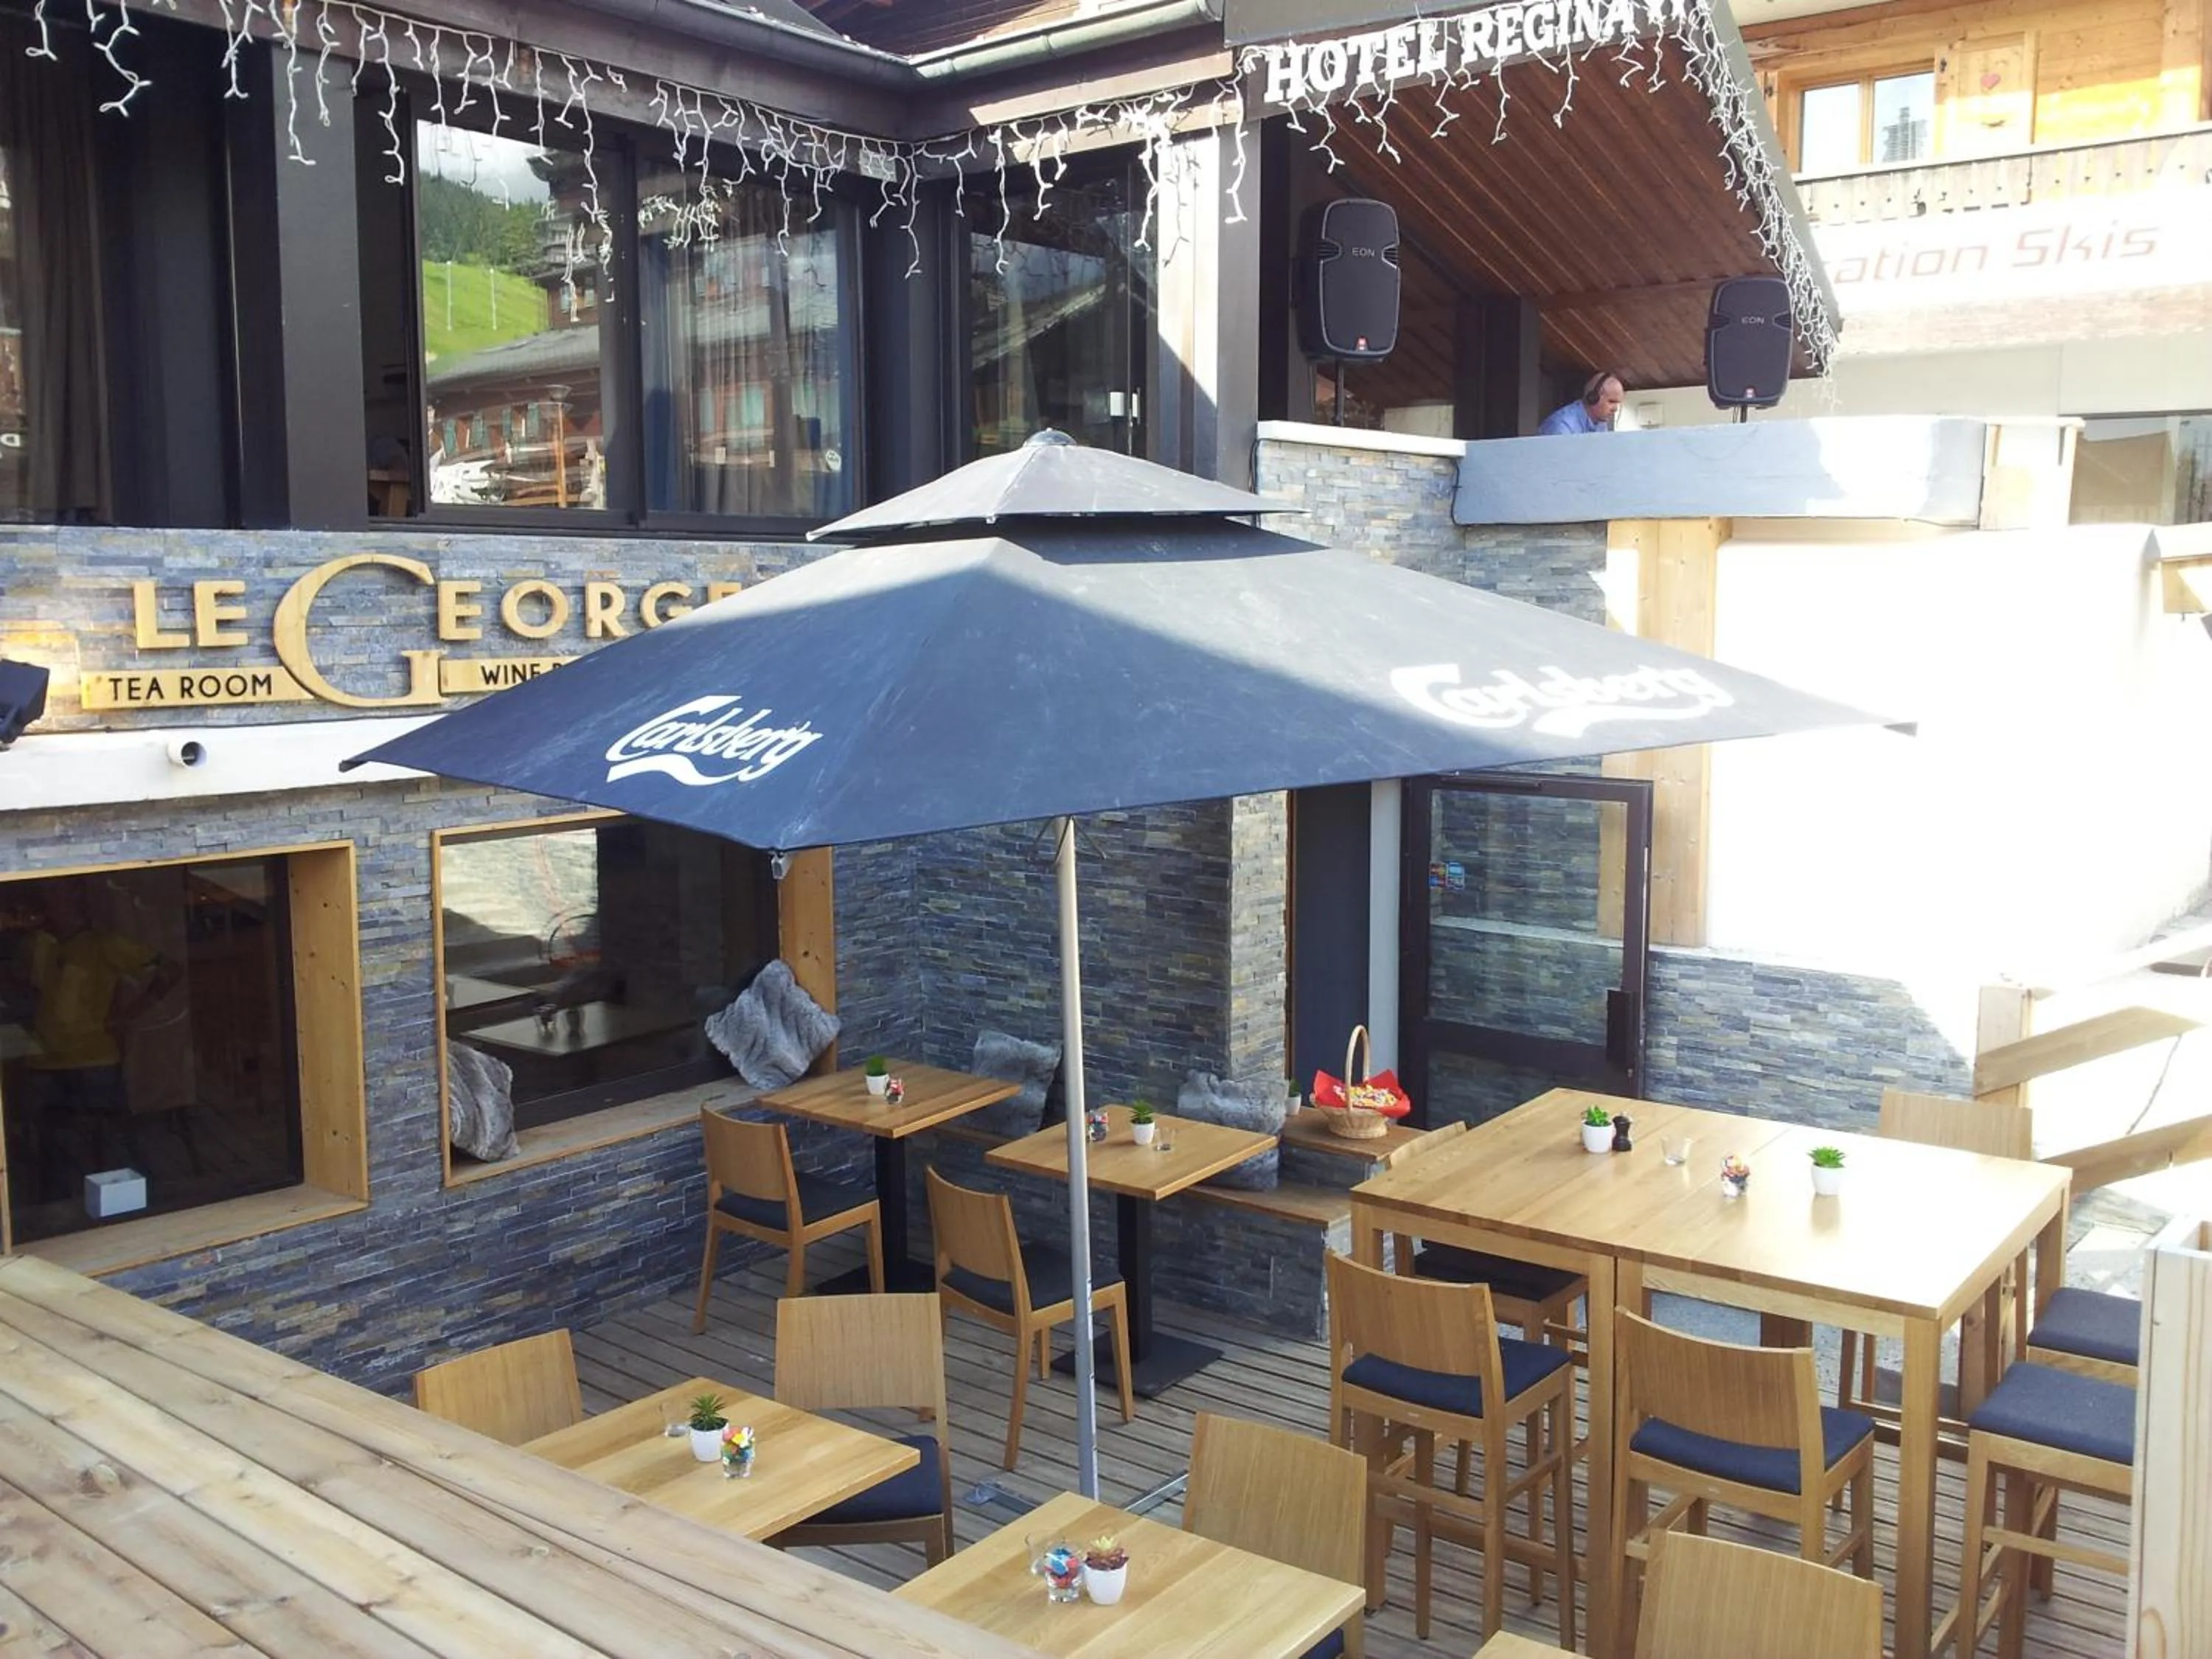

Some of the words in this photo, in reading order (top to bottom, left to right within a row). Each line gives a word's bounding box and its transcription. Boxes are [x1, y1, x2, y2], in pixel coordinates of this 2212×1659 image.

[1264, 19, 1446, 102] HOTEL
[1461, 0, 1637, 65] REGINA
[1352, 248, 1375, 257] EON
[1821, 242, 1989, 285] ation
[2012, 219, 2160, 267] Skis
[1741, 316, 1764, 324] EON
[133, 580, 248, 649] LE
[109, 676, 164, 700] TEA
[180, 674, 273, 699] ROOM
[480, 664, 542, 684] WINE
[1390, 664, 1735, 738] Carlsberg
[605, 695, 824, 786] Carlsberg
